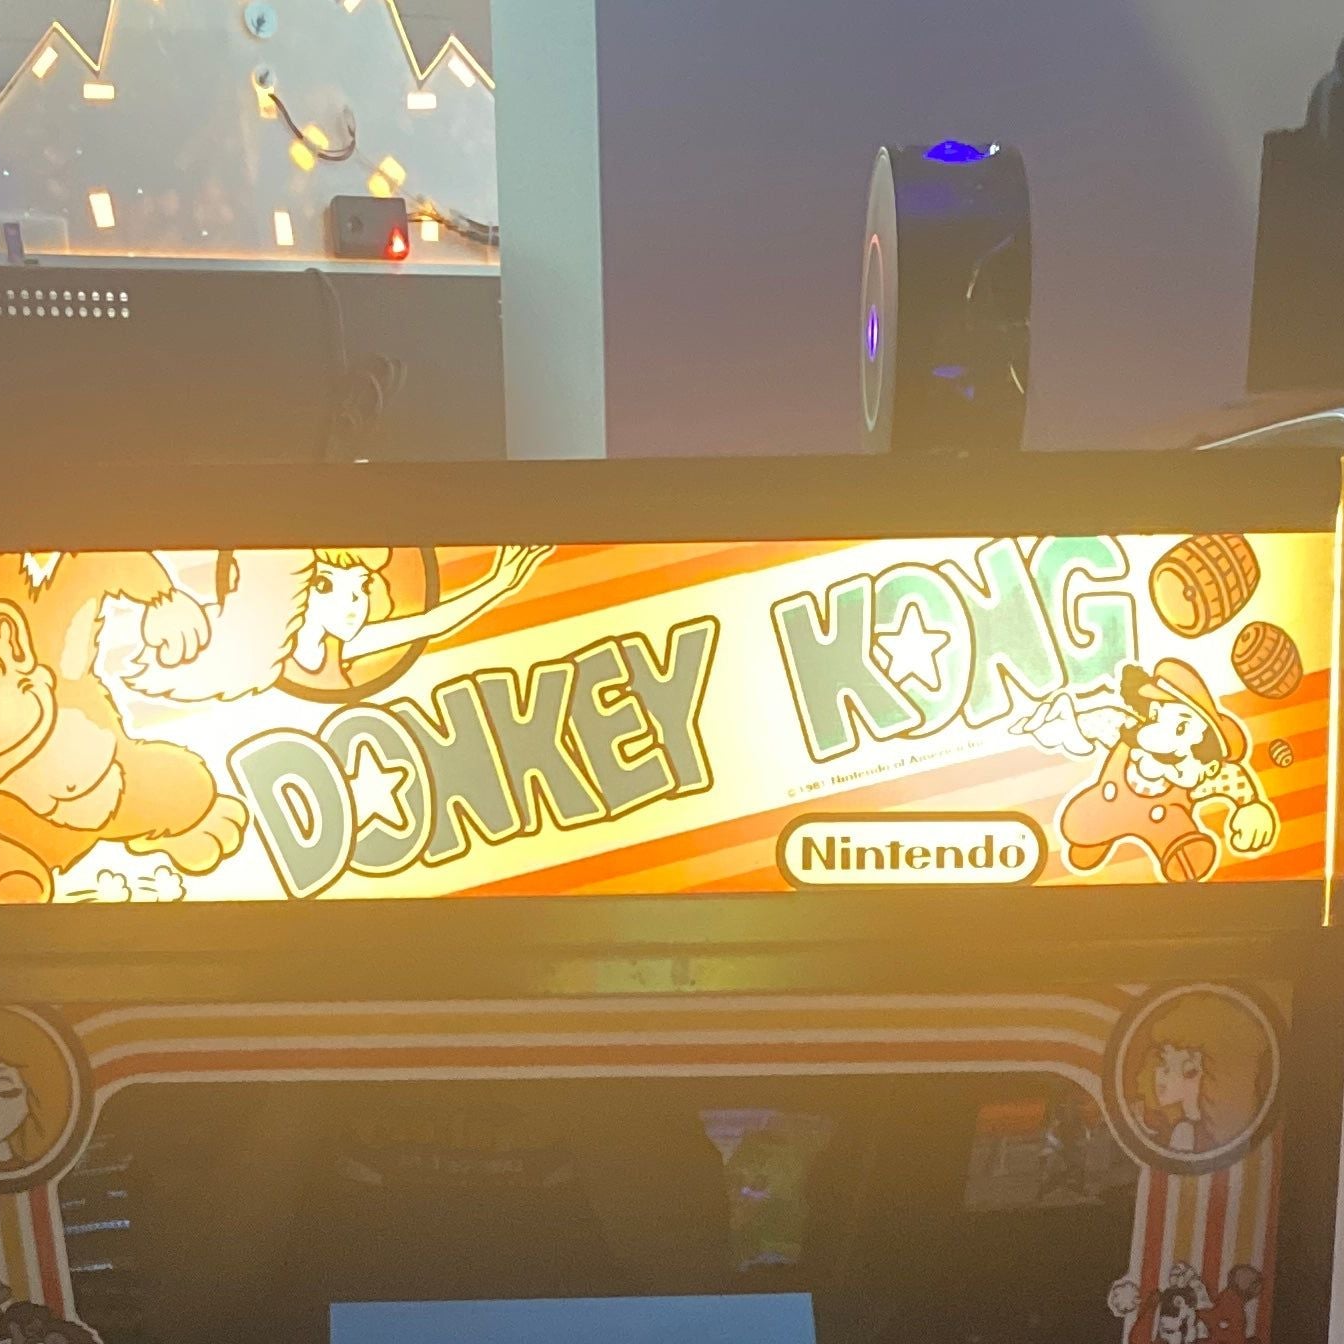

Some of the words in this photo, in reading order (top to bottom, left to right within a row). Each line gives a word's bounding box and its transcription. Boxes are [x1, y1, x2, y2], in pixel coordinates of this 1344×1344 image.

[226, 614, 721, 900] DONKEY
[770, 535, 1139, 764] KONG
[801, 834, 1026, 871] Nintendo
